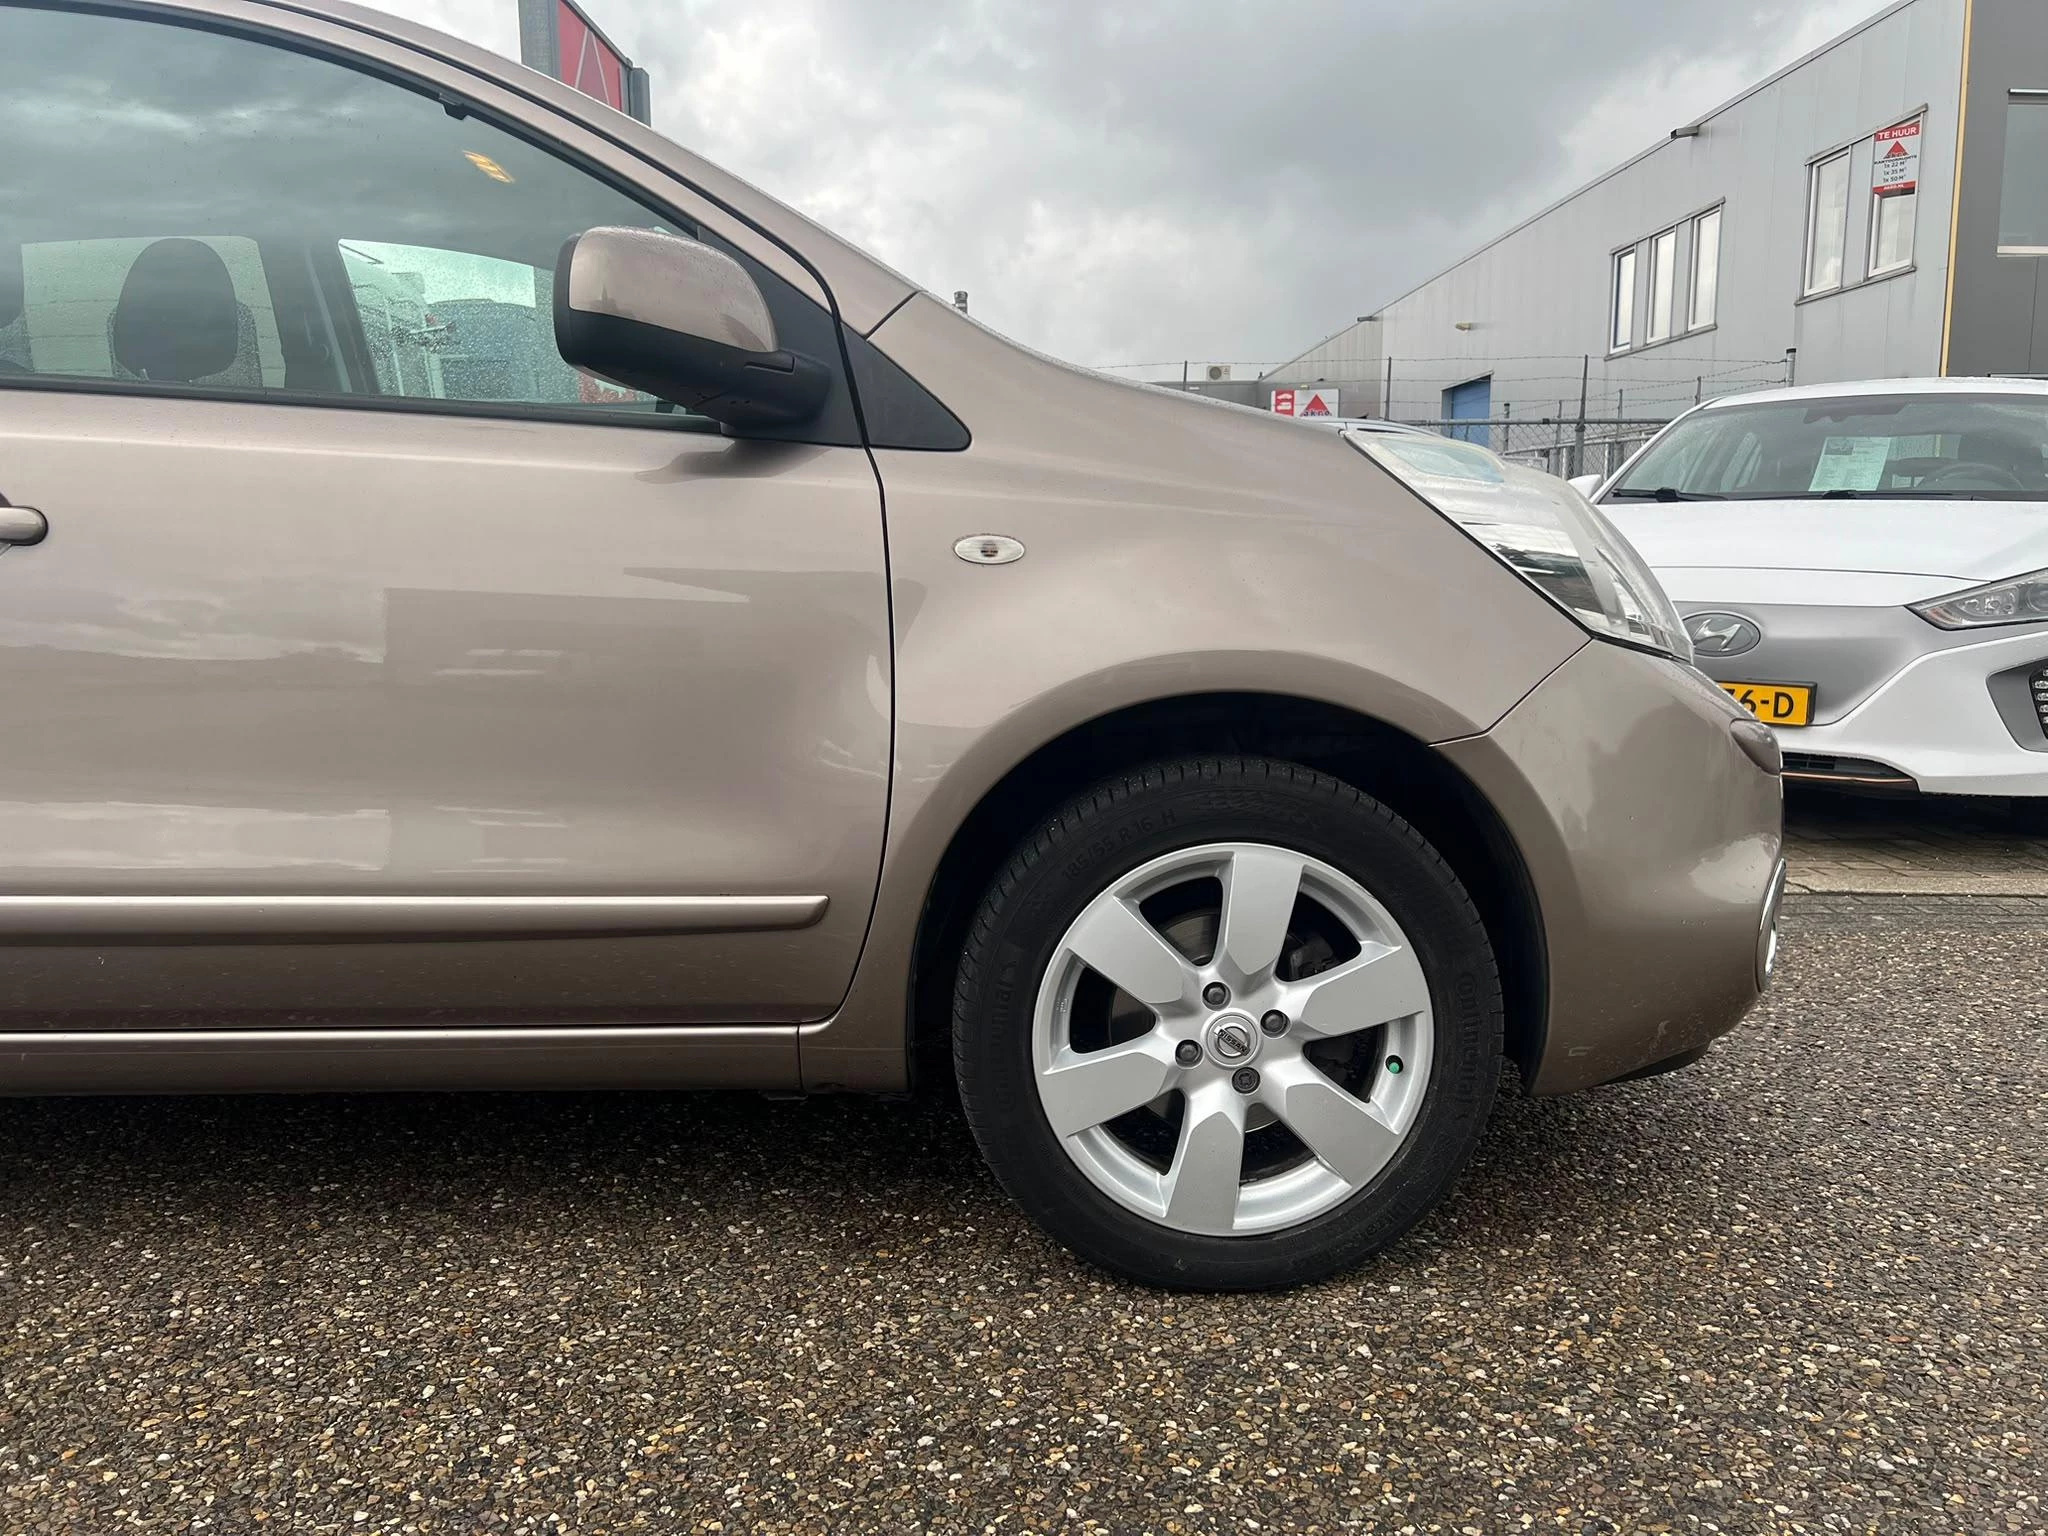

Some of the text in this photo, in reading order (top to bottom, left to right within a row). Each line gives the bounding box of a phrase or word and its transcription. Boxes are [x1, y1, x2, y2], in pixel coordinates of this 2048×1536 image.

[1878, 126, 1917, 140] TE HUUR
[1160, 808, 1177, 826] H
[1219, 1030, 1248, 1053] NISSAN
